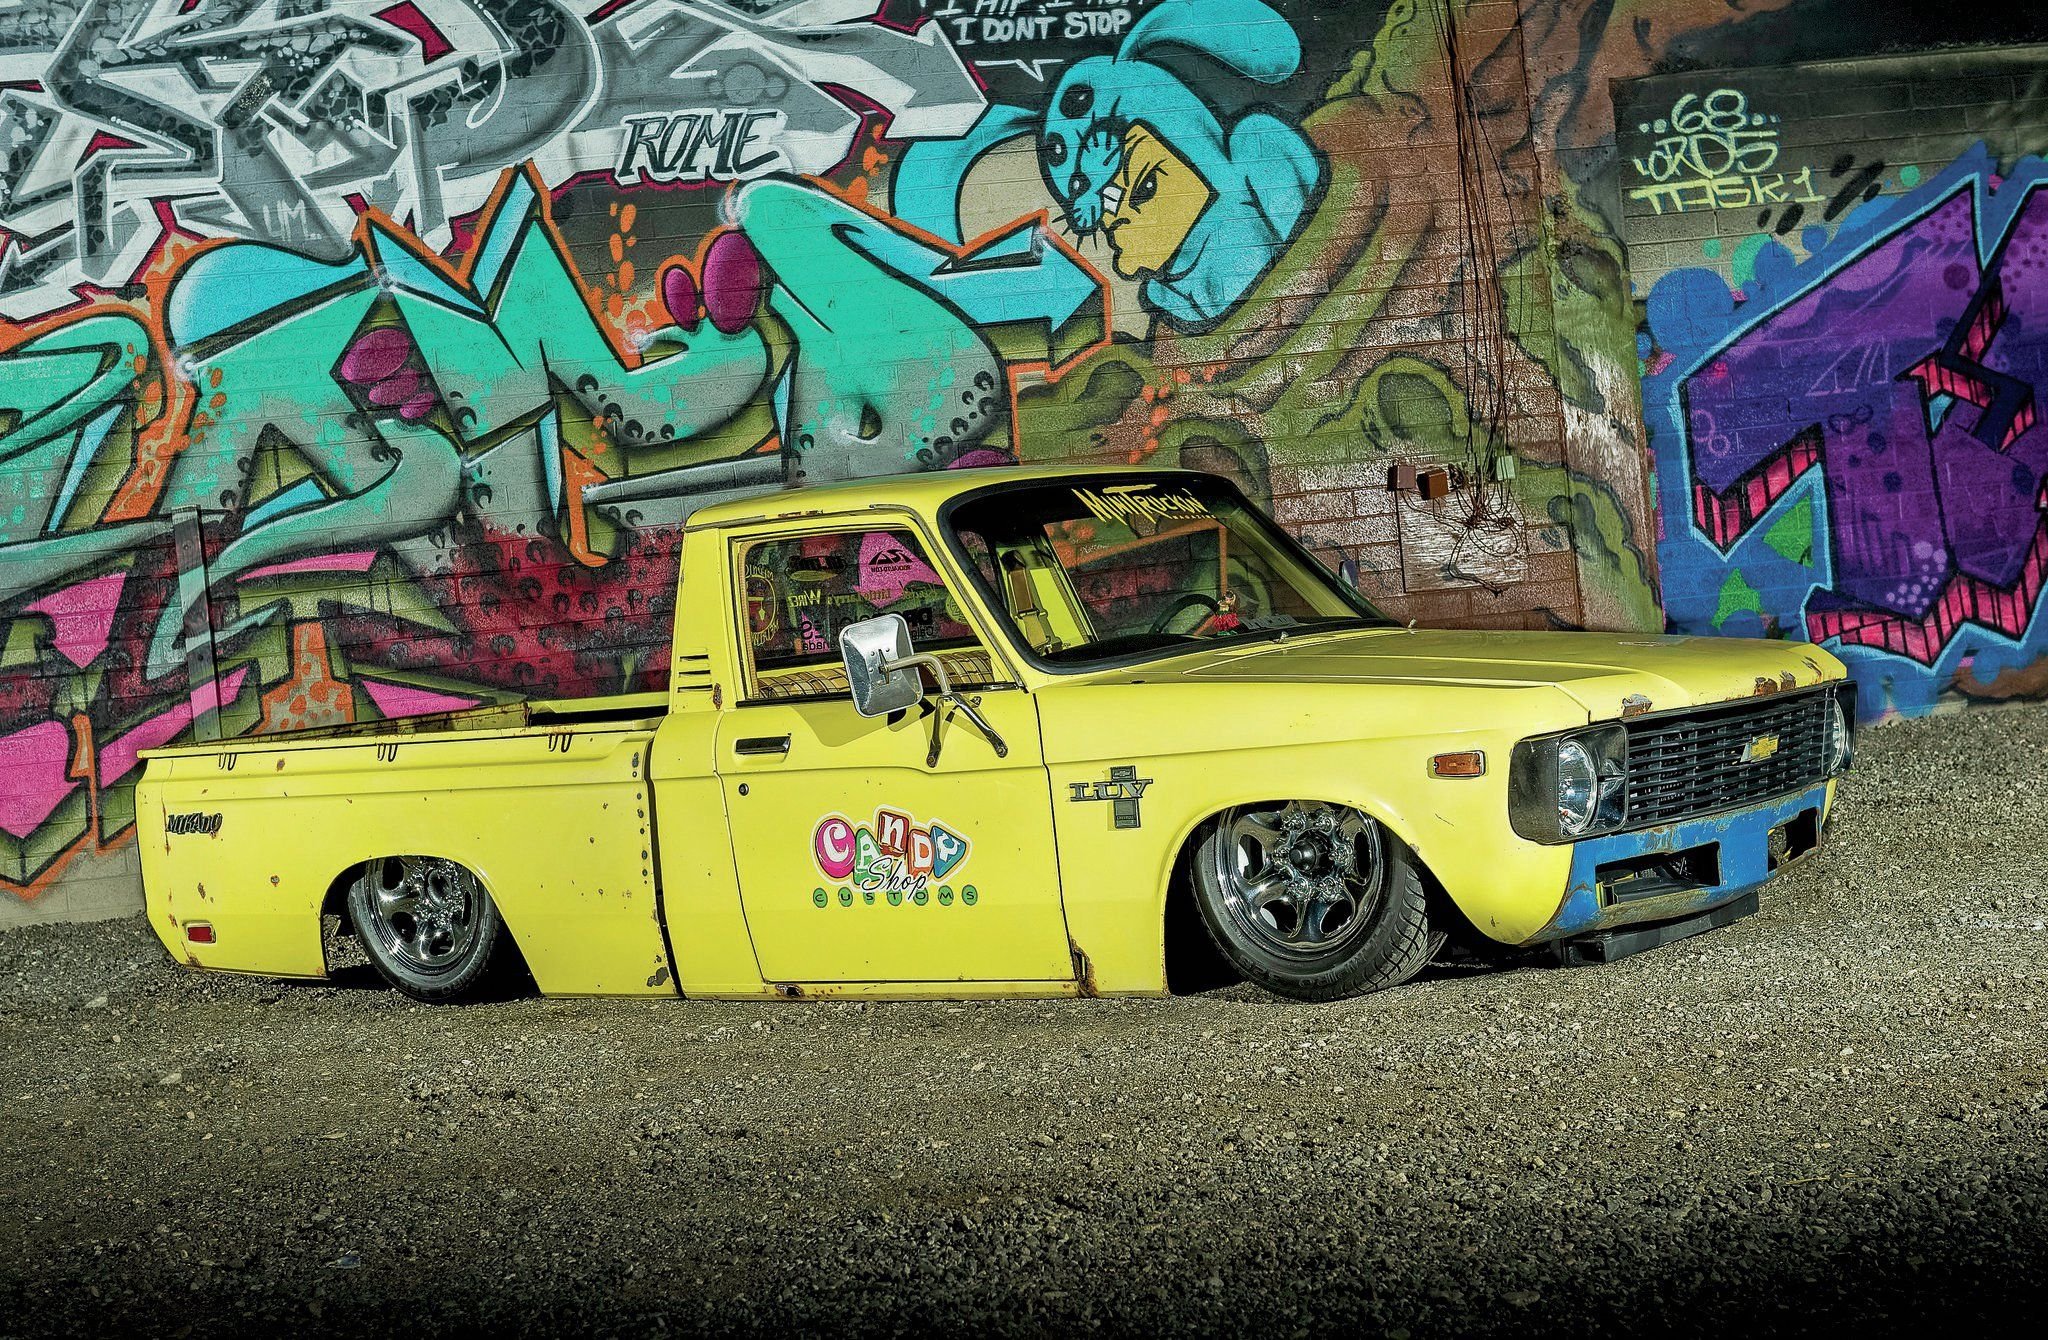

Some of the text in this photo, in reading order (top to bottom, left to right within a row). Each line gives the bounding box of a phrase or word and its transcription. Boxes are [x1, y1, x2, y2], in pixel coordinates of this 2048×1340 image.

[951, 8, 1132, 45] I DONT STOP
[1671, 88, 1748, 134] 68
[617, 111, 780, 178] ROME
[1069, 779, 1153, 802] LUV
[165, 812, 223, 835] MIKADO
[814, 887, 976, 905] CUSTOMS
[861, 856, 928, 901] Shop
